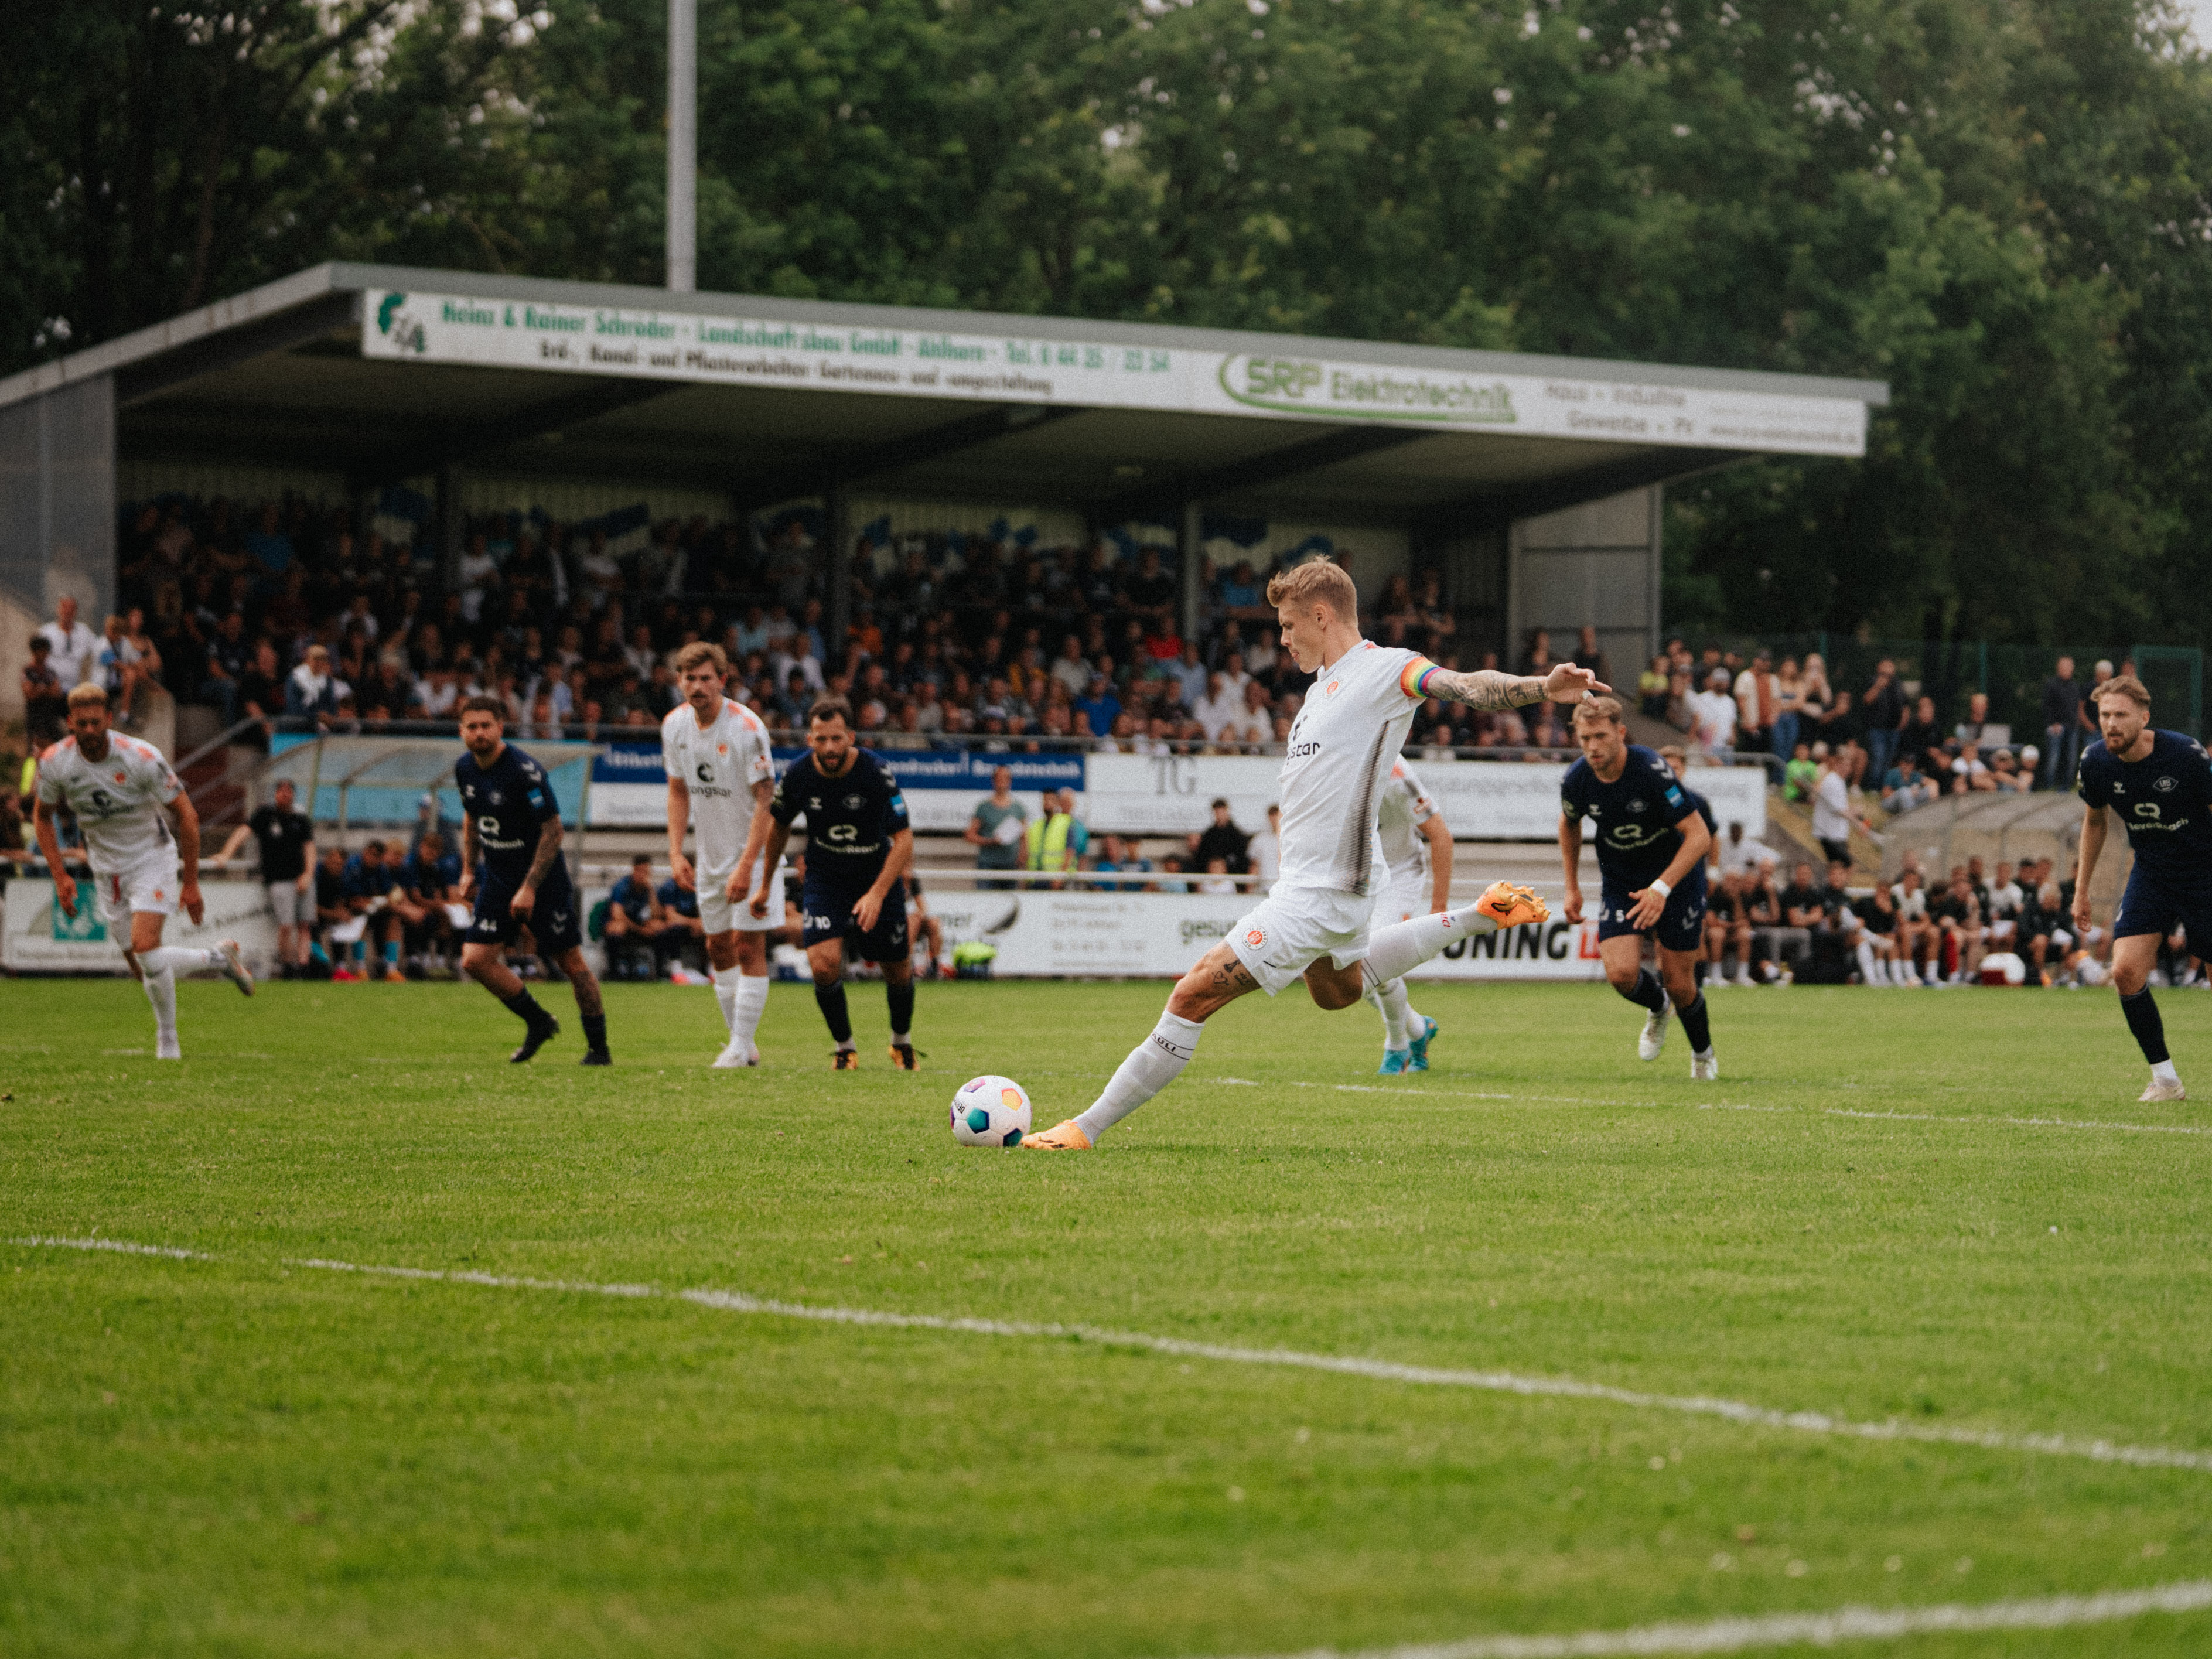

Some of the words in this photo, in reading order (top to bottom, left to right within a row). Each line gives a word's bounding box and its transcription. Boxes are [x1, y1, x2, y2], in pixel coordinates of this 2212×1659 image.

[442, 299, 494, 326] Heinz
[504, 305, 517, 327] &
[525, 305, 586, 332] Rainer
[1247, 359, 1322, 398] SRP
[1332, 371, 1514, 412] Elektrotechnik
[1288, 742, 1320, 760] star
[815, 916, 831, 930] 10
[1152, 1033, 1176, 1053] AULI
